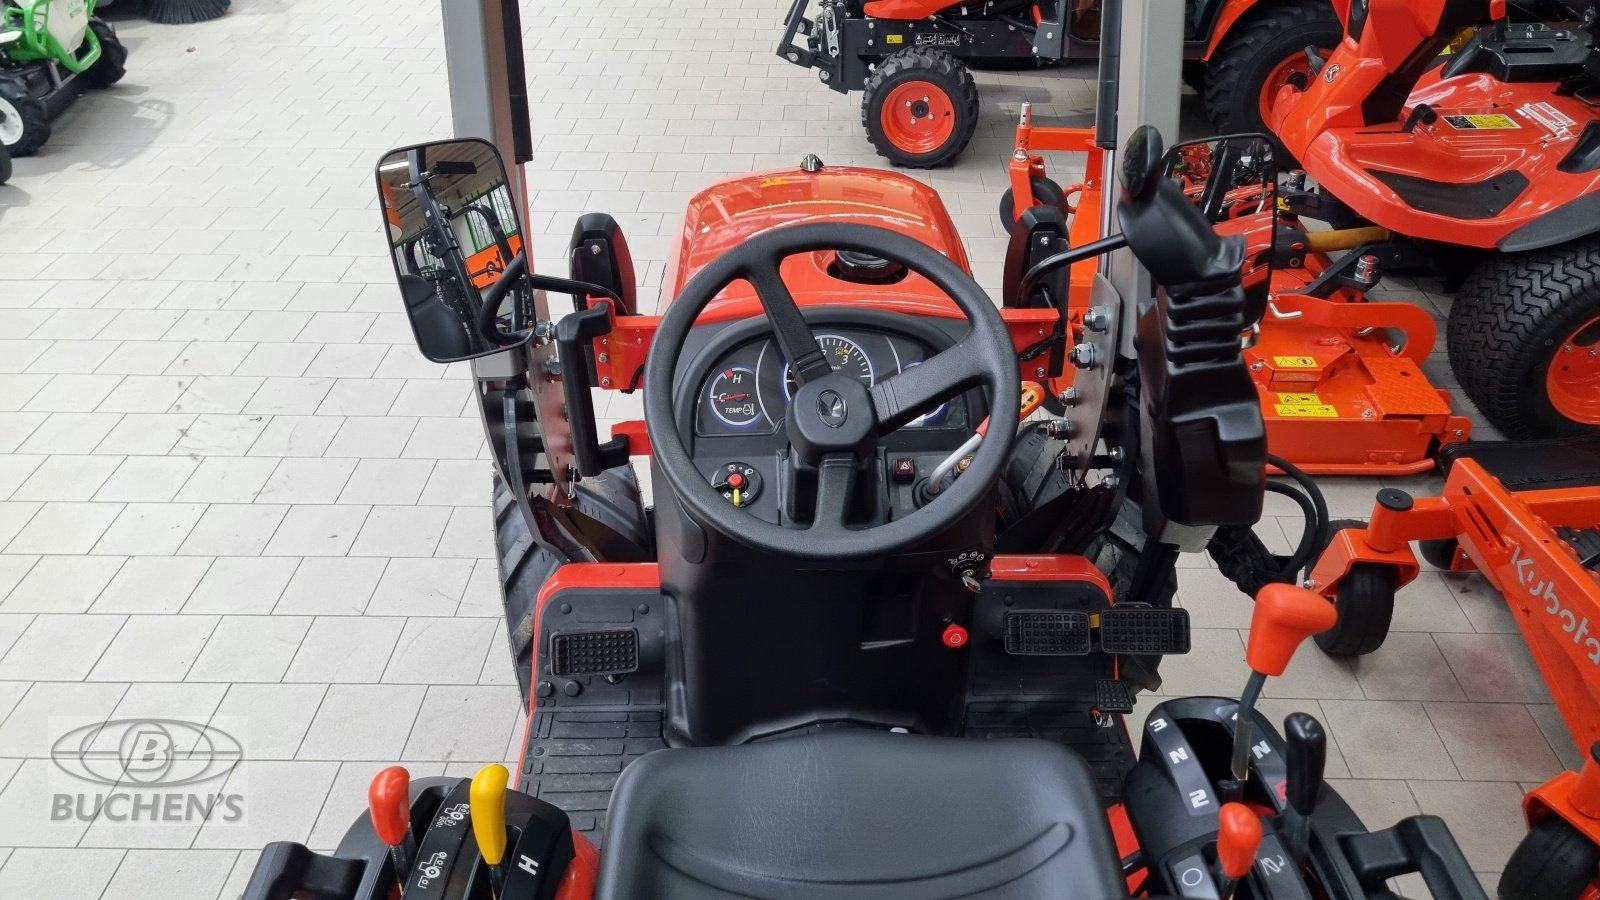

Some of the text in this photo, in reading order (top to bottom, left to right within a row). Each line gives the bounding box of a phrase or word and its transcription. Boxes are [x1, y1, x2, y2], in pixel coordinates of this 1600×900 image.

[841, 354, 849, 365] 3
[732, 374, 742, 384] H
[718, 392, 727, 402] C
[724, 407, 742, 415] TEMP
[1510, 545, 1600, 665] Kubota
[1149, 717, 1168, 732] 3
[1169, 747, 1189, 764] N
[1252, 740, 1271, 759] N
[1189, 788, 1210, 809] 2
[517, 854, 540, 876] H
